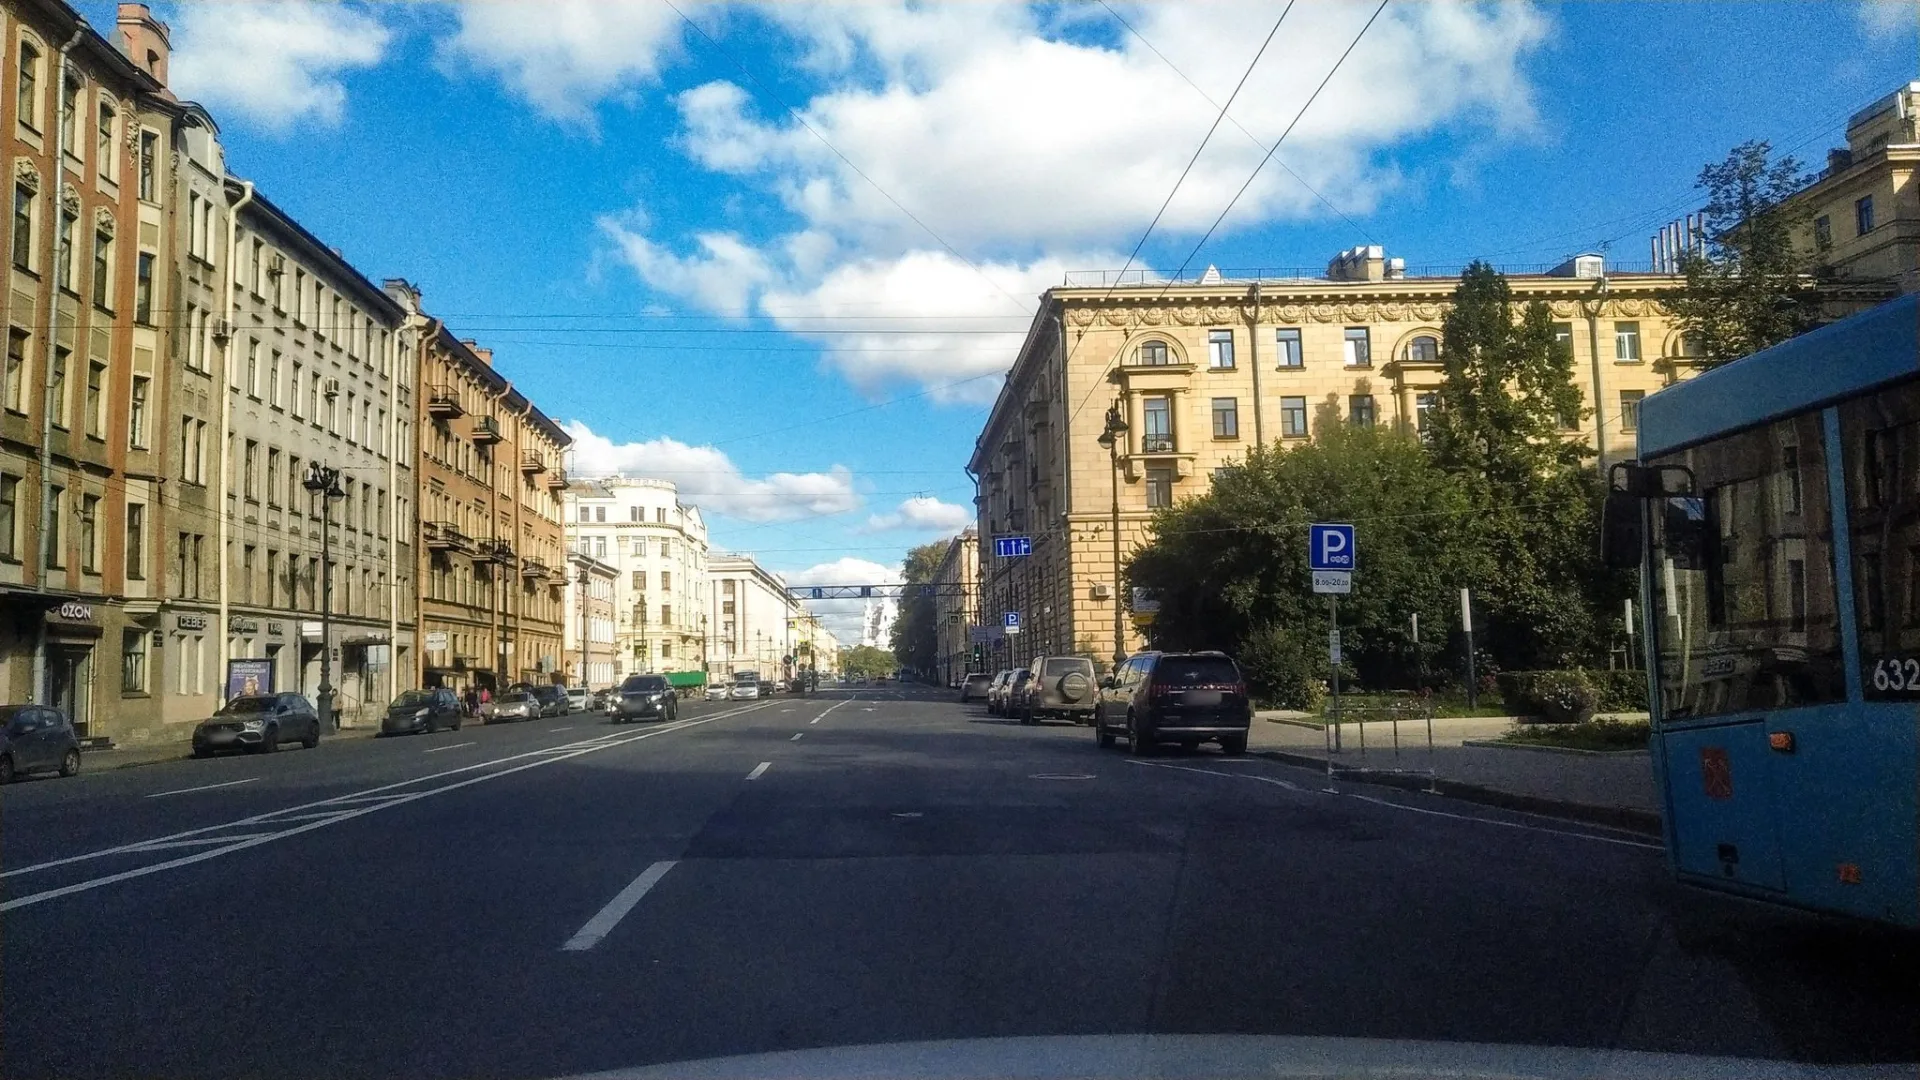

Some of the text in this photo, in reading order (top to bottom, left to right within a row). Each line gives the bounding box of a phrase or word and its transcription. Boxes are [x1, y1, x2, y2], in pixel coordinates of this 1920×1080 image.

[1322, 530, 1346, 564] P
[61, 604, 91, 619] OZON
[1874, 658, 1920, 691] 632
